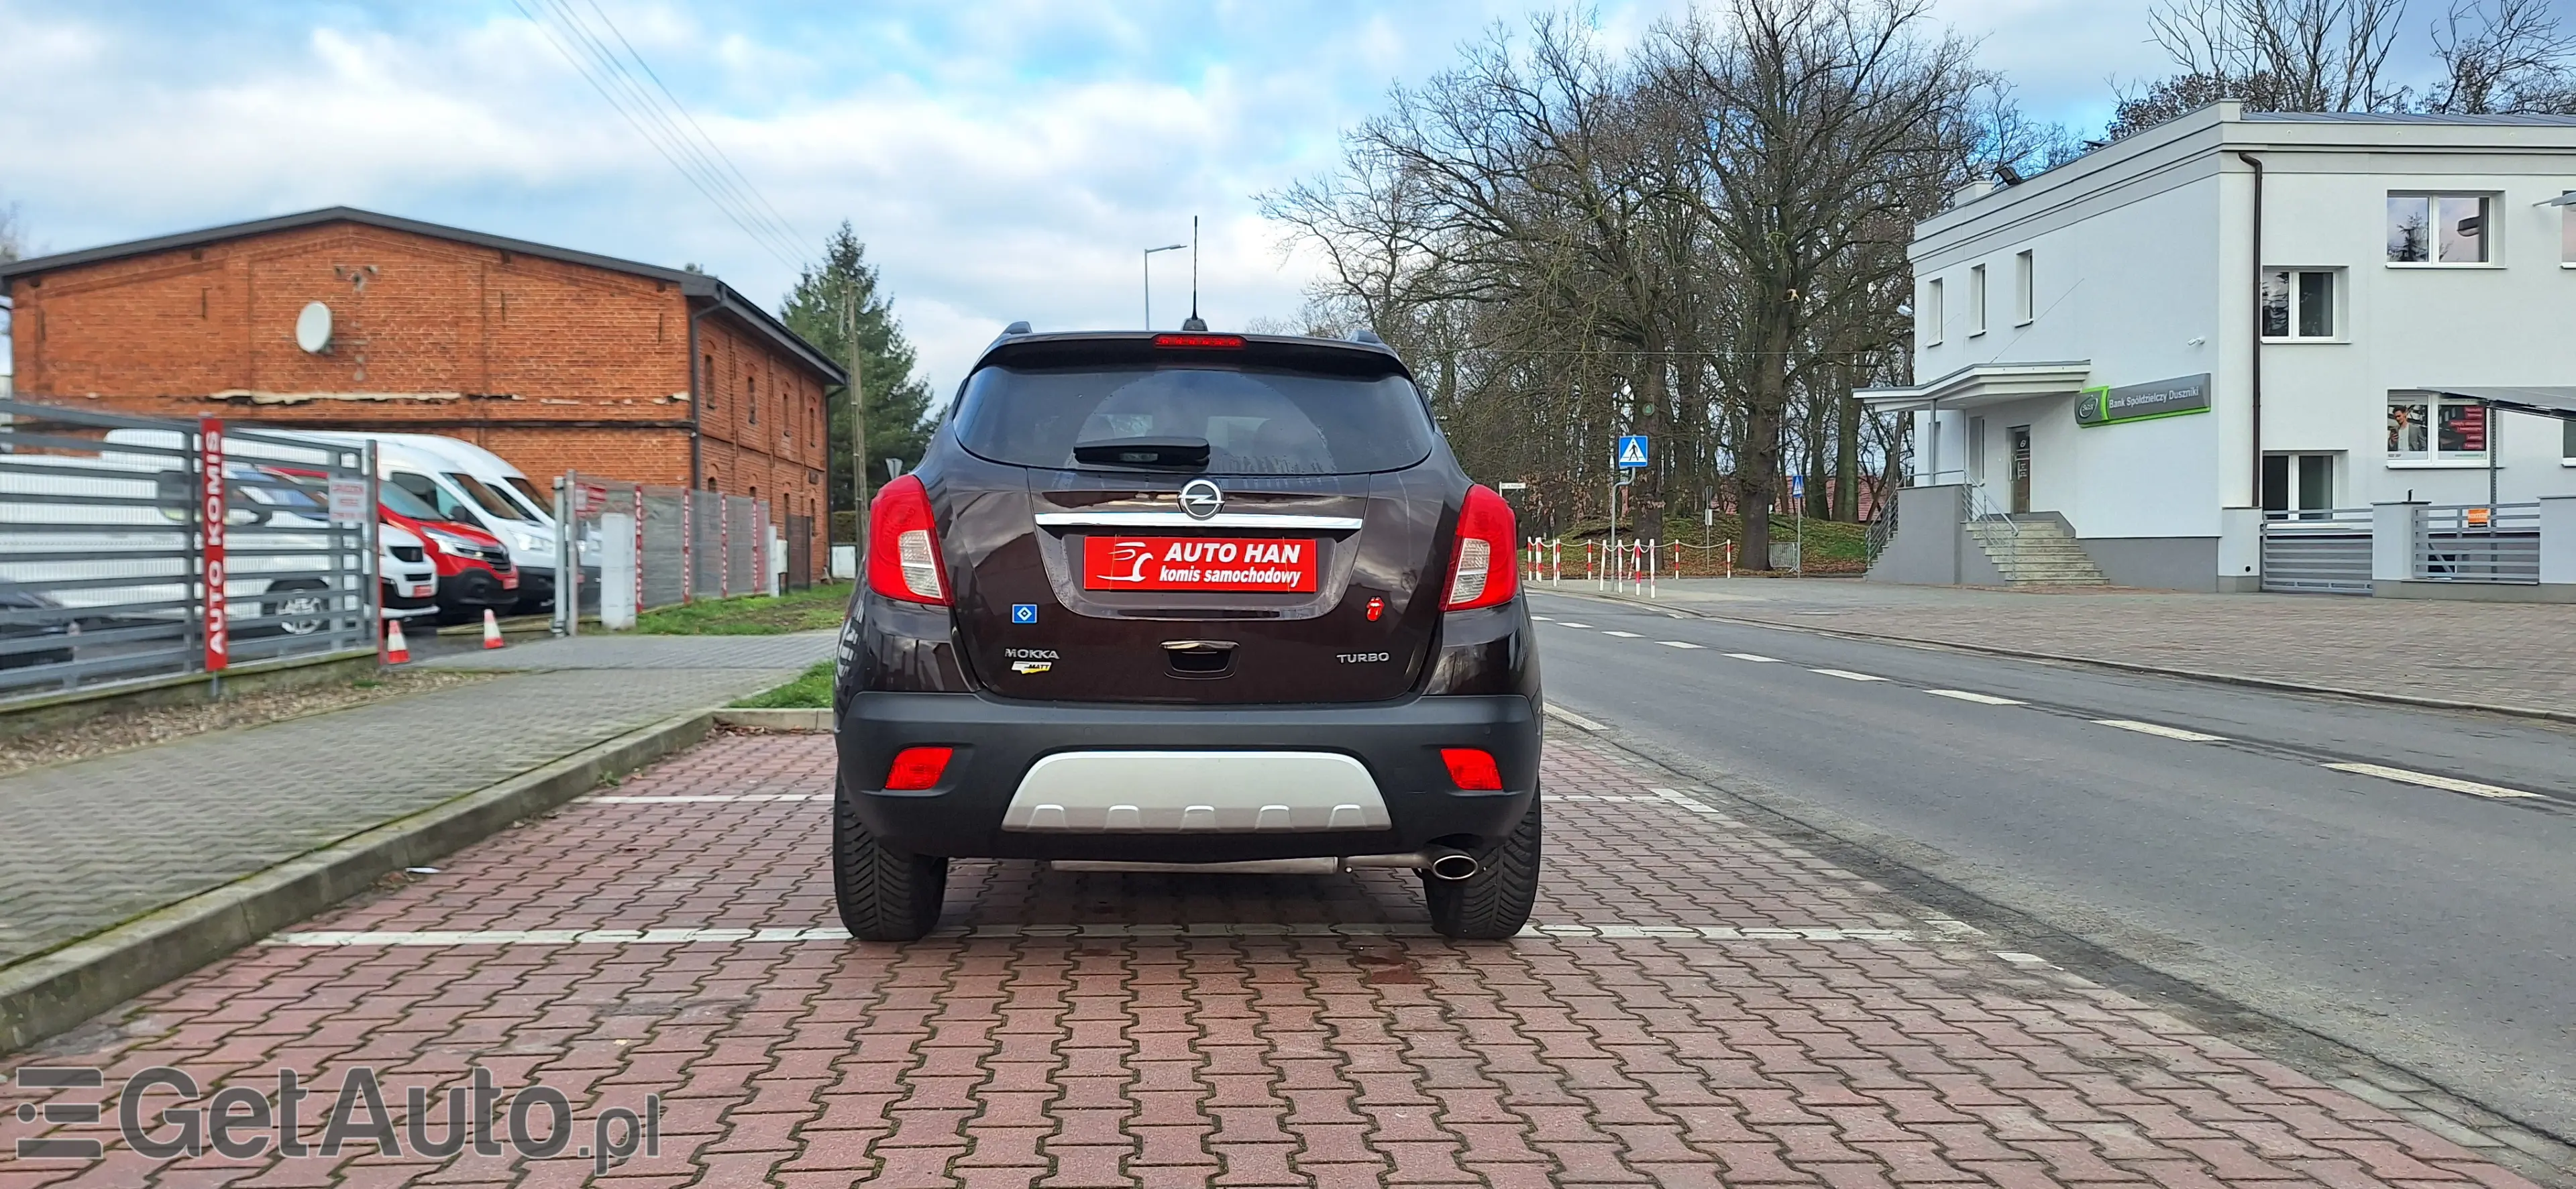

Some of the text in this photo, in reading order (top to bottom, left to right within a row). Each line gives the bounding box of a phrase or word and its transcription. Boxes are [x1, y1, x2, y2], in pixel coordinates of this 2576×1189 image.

[2108, 398, 2125, 408] Bank
[2169, 386, 2199, 400] Duszniki
[206, 431, 225, 655] AUTO KOMIS
[1163, 542, 1301, 563] AUTO HAN
[1159, 565, 1301, 587] komis samochodowy
[1004, 648, 1060, 659] MOKKA
[1336, 652, 1390, 663] TURBO
